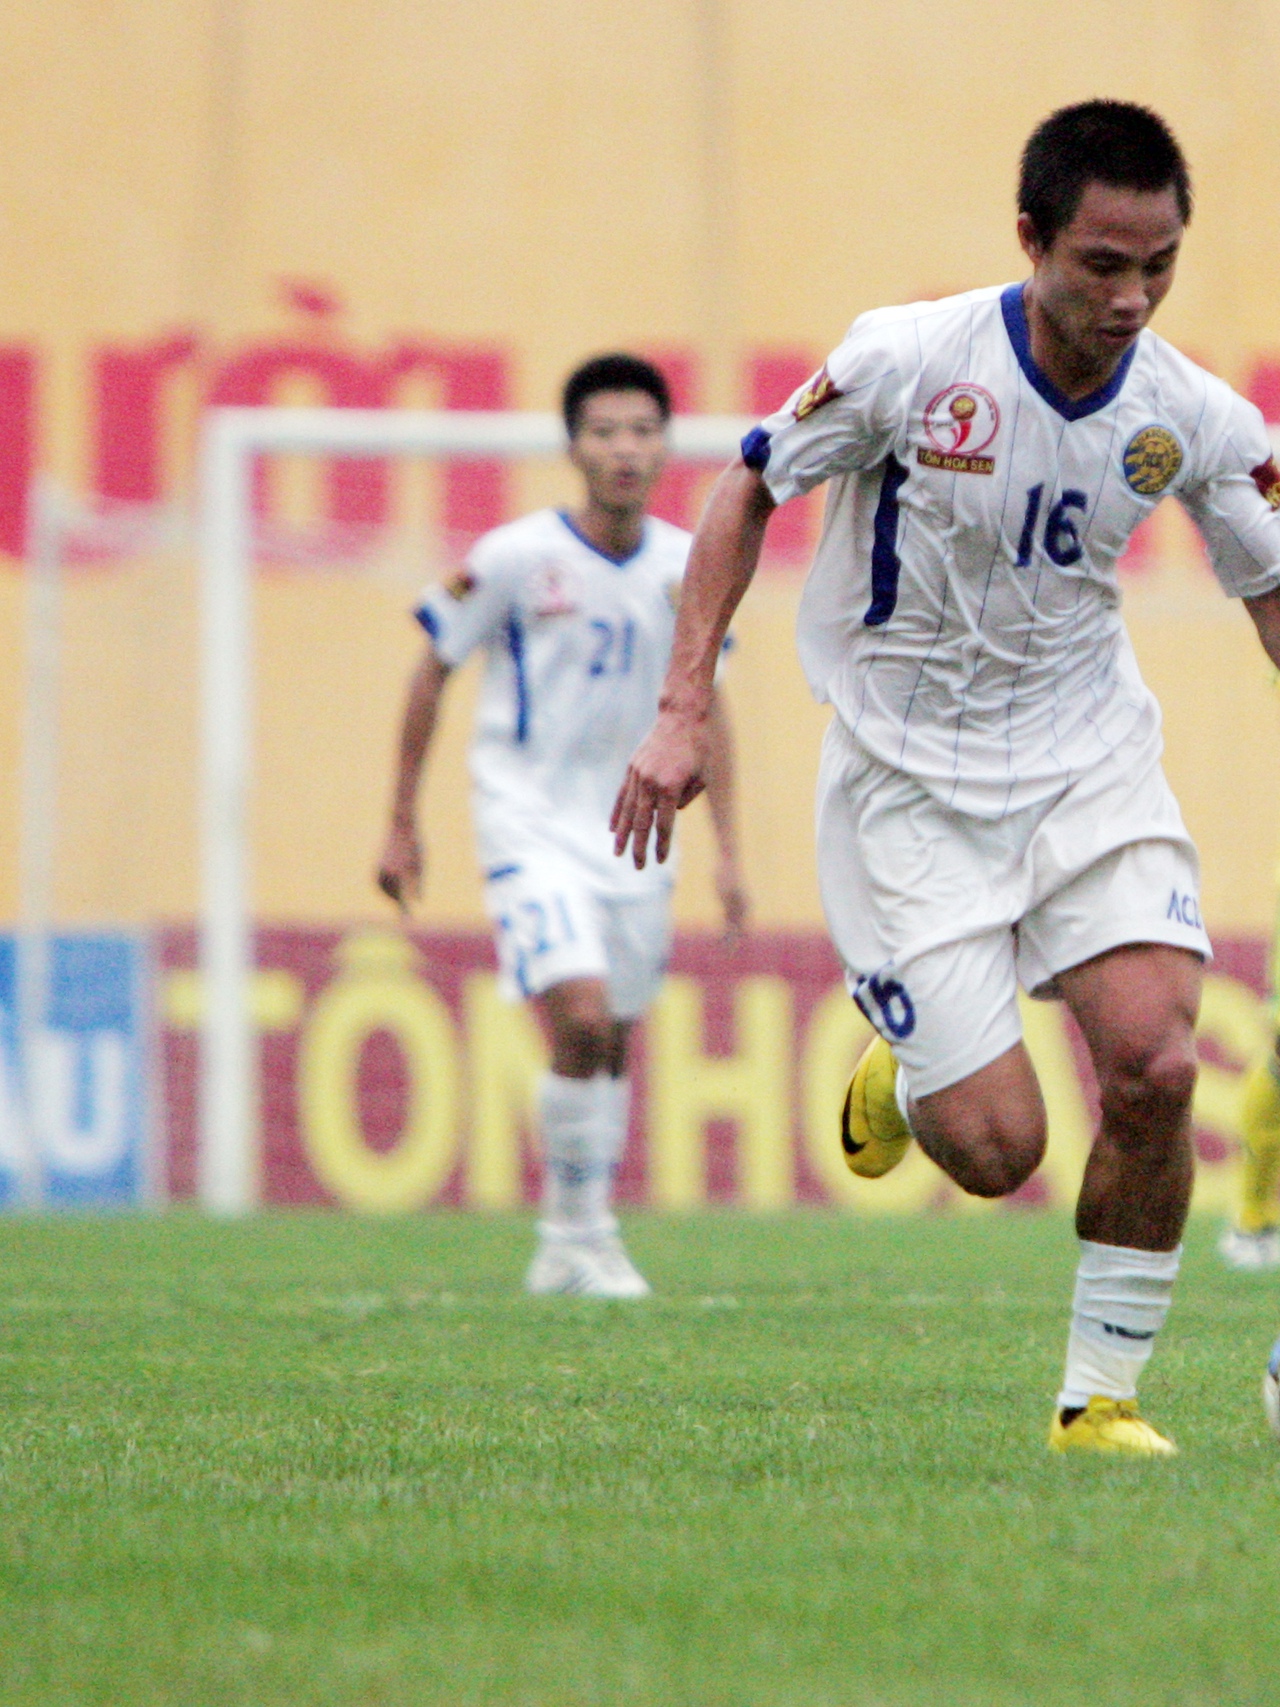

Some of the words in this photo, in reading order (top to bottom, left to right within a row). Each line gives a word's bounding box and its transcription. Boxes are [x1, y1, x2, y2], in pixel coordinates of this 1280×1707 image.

[943, 456, 969, 469] HOA
[970, 460, 994, 471] SEN
[1014, 480, 1088, 567] 16
[588, 617, 636, 675] 21
